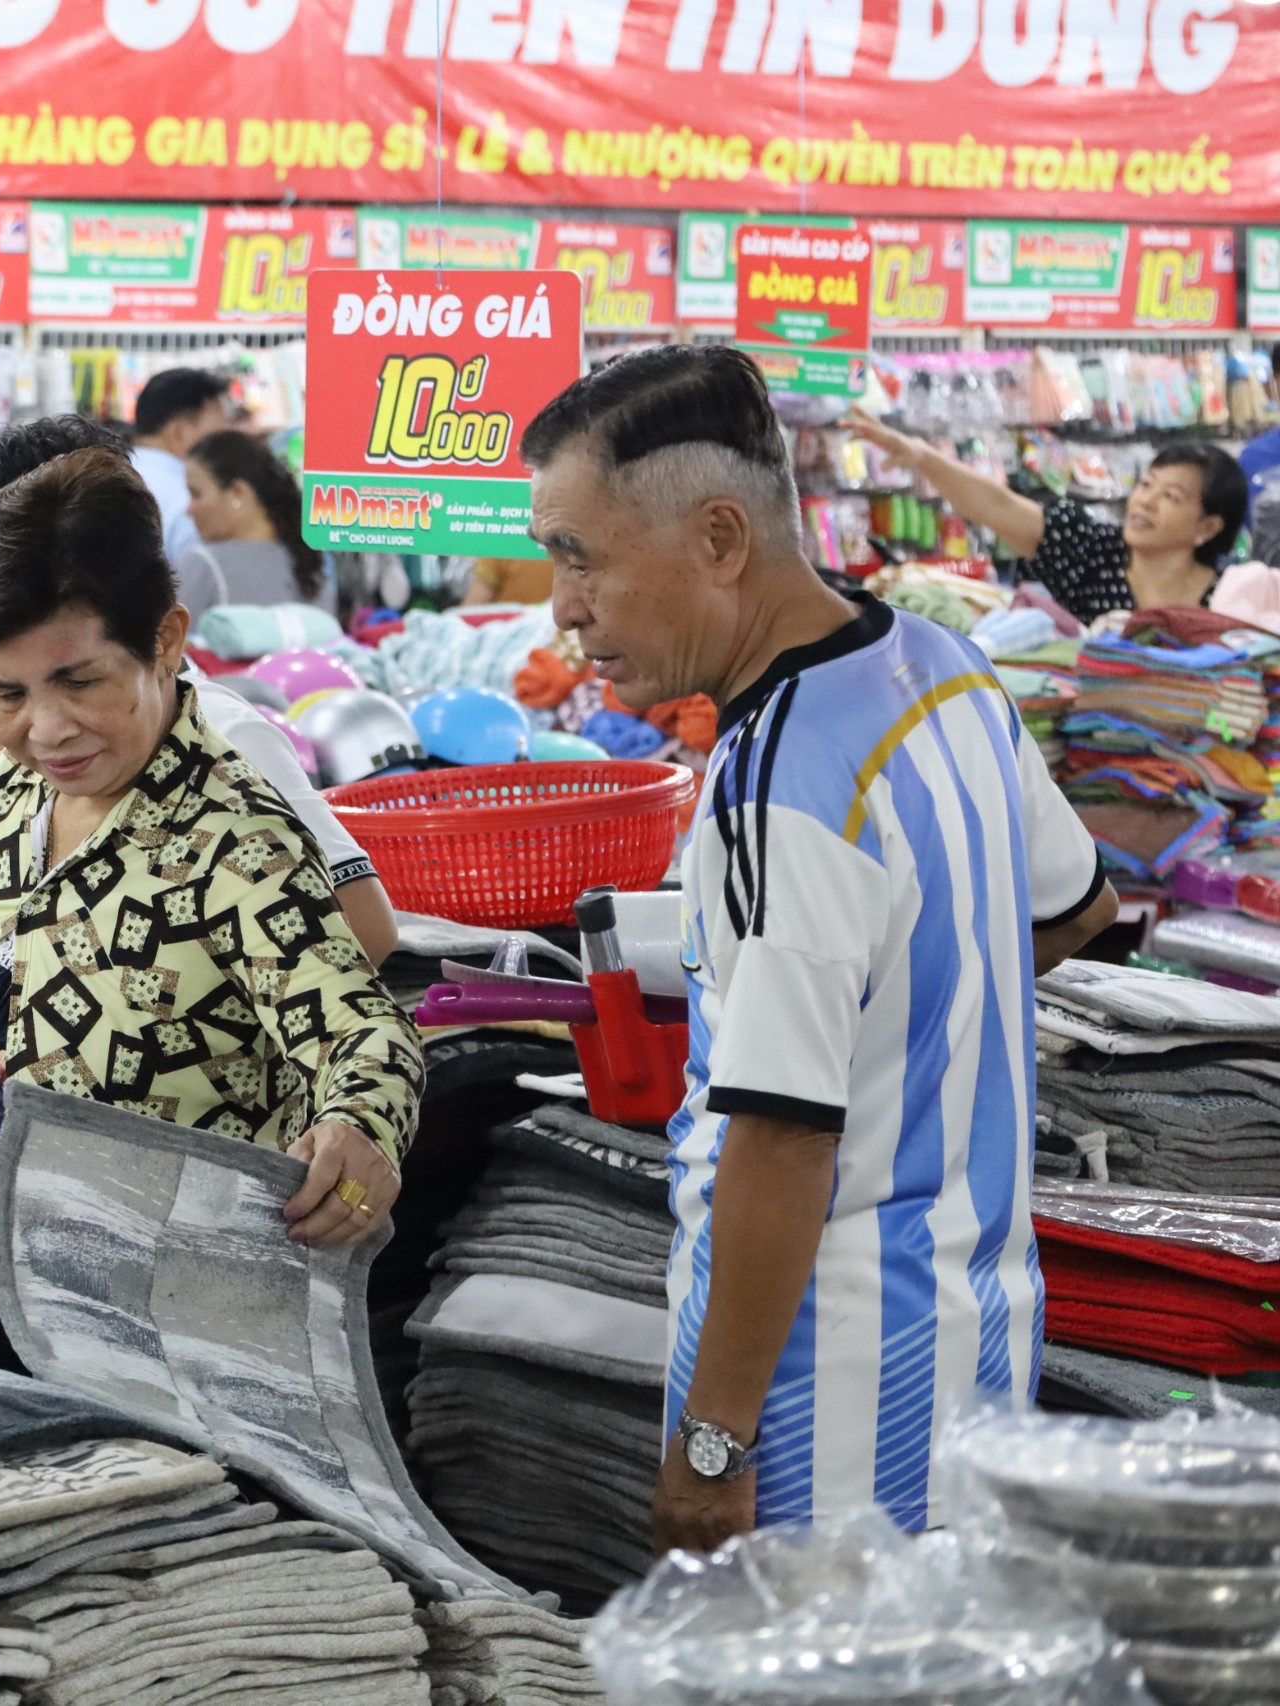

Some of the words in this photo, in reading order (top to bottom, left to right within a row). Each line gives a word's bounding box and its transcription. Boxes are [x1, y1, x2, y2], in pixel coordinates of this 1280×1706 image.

[146, 117, 228, 168] GIA
[237, 118, 373, 181] DỤNG
[518, 127, 552, 176] &
[907, 134, 1006, 190] TRÊN
[1013, 139, 1117, 193] TOÀN
[332, 273, 463, 337] ĐỒNG
[474, 283, 552, 338] GIÁ
[819, 271, 858, 306] GIÁ
[309, 484, 433, 530] MDmart
